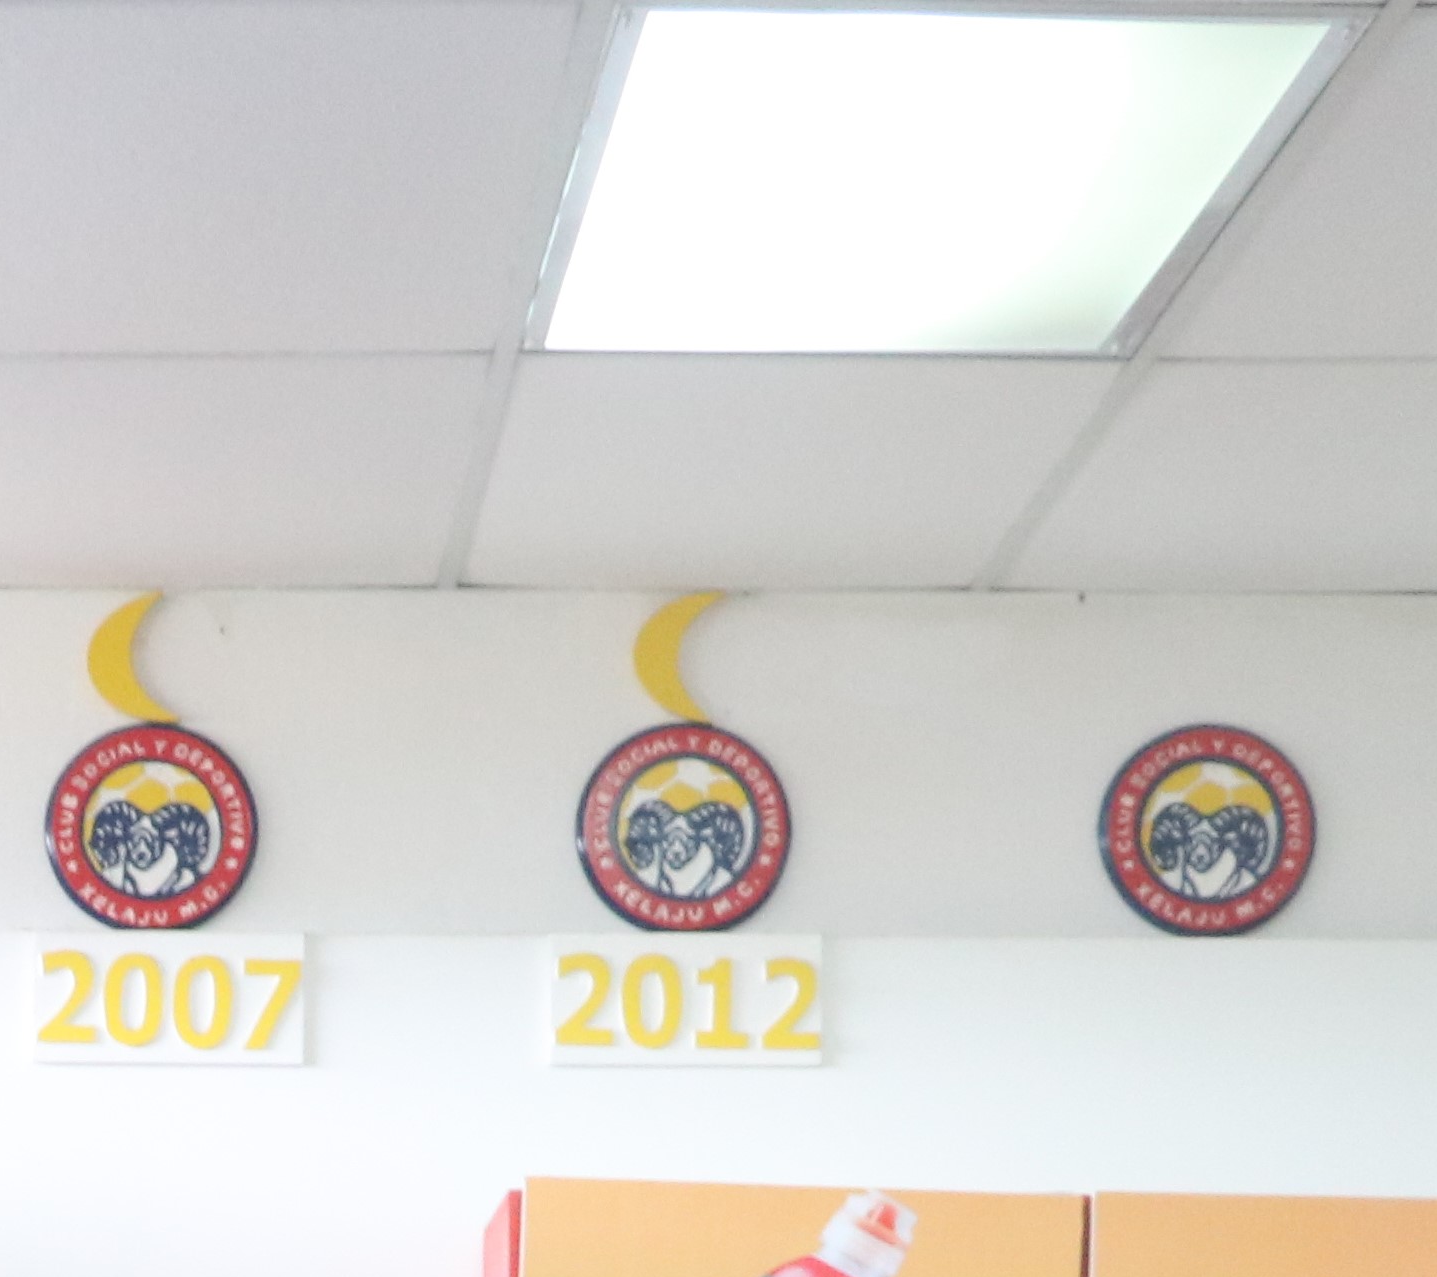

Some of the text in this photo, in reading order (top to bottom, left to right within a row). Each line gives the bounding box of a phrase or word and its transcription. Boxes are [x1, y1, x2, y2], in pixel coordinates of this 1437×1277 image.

[60, 793, 78, 853] CLUB
[72, 741, 145, 789] SOCIAL
[38, 949, 304, 1051] 2007
[555, 952, 822, 1051] 2012
